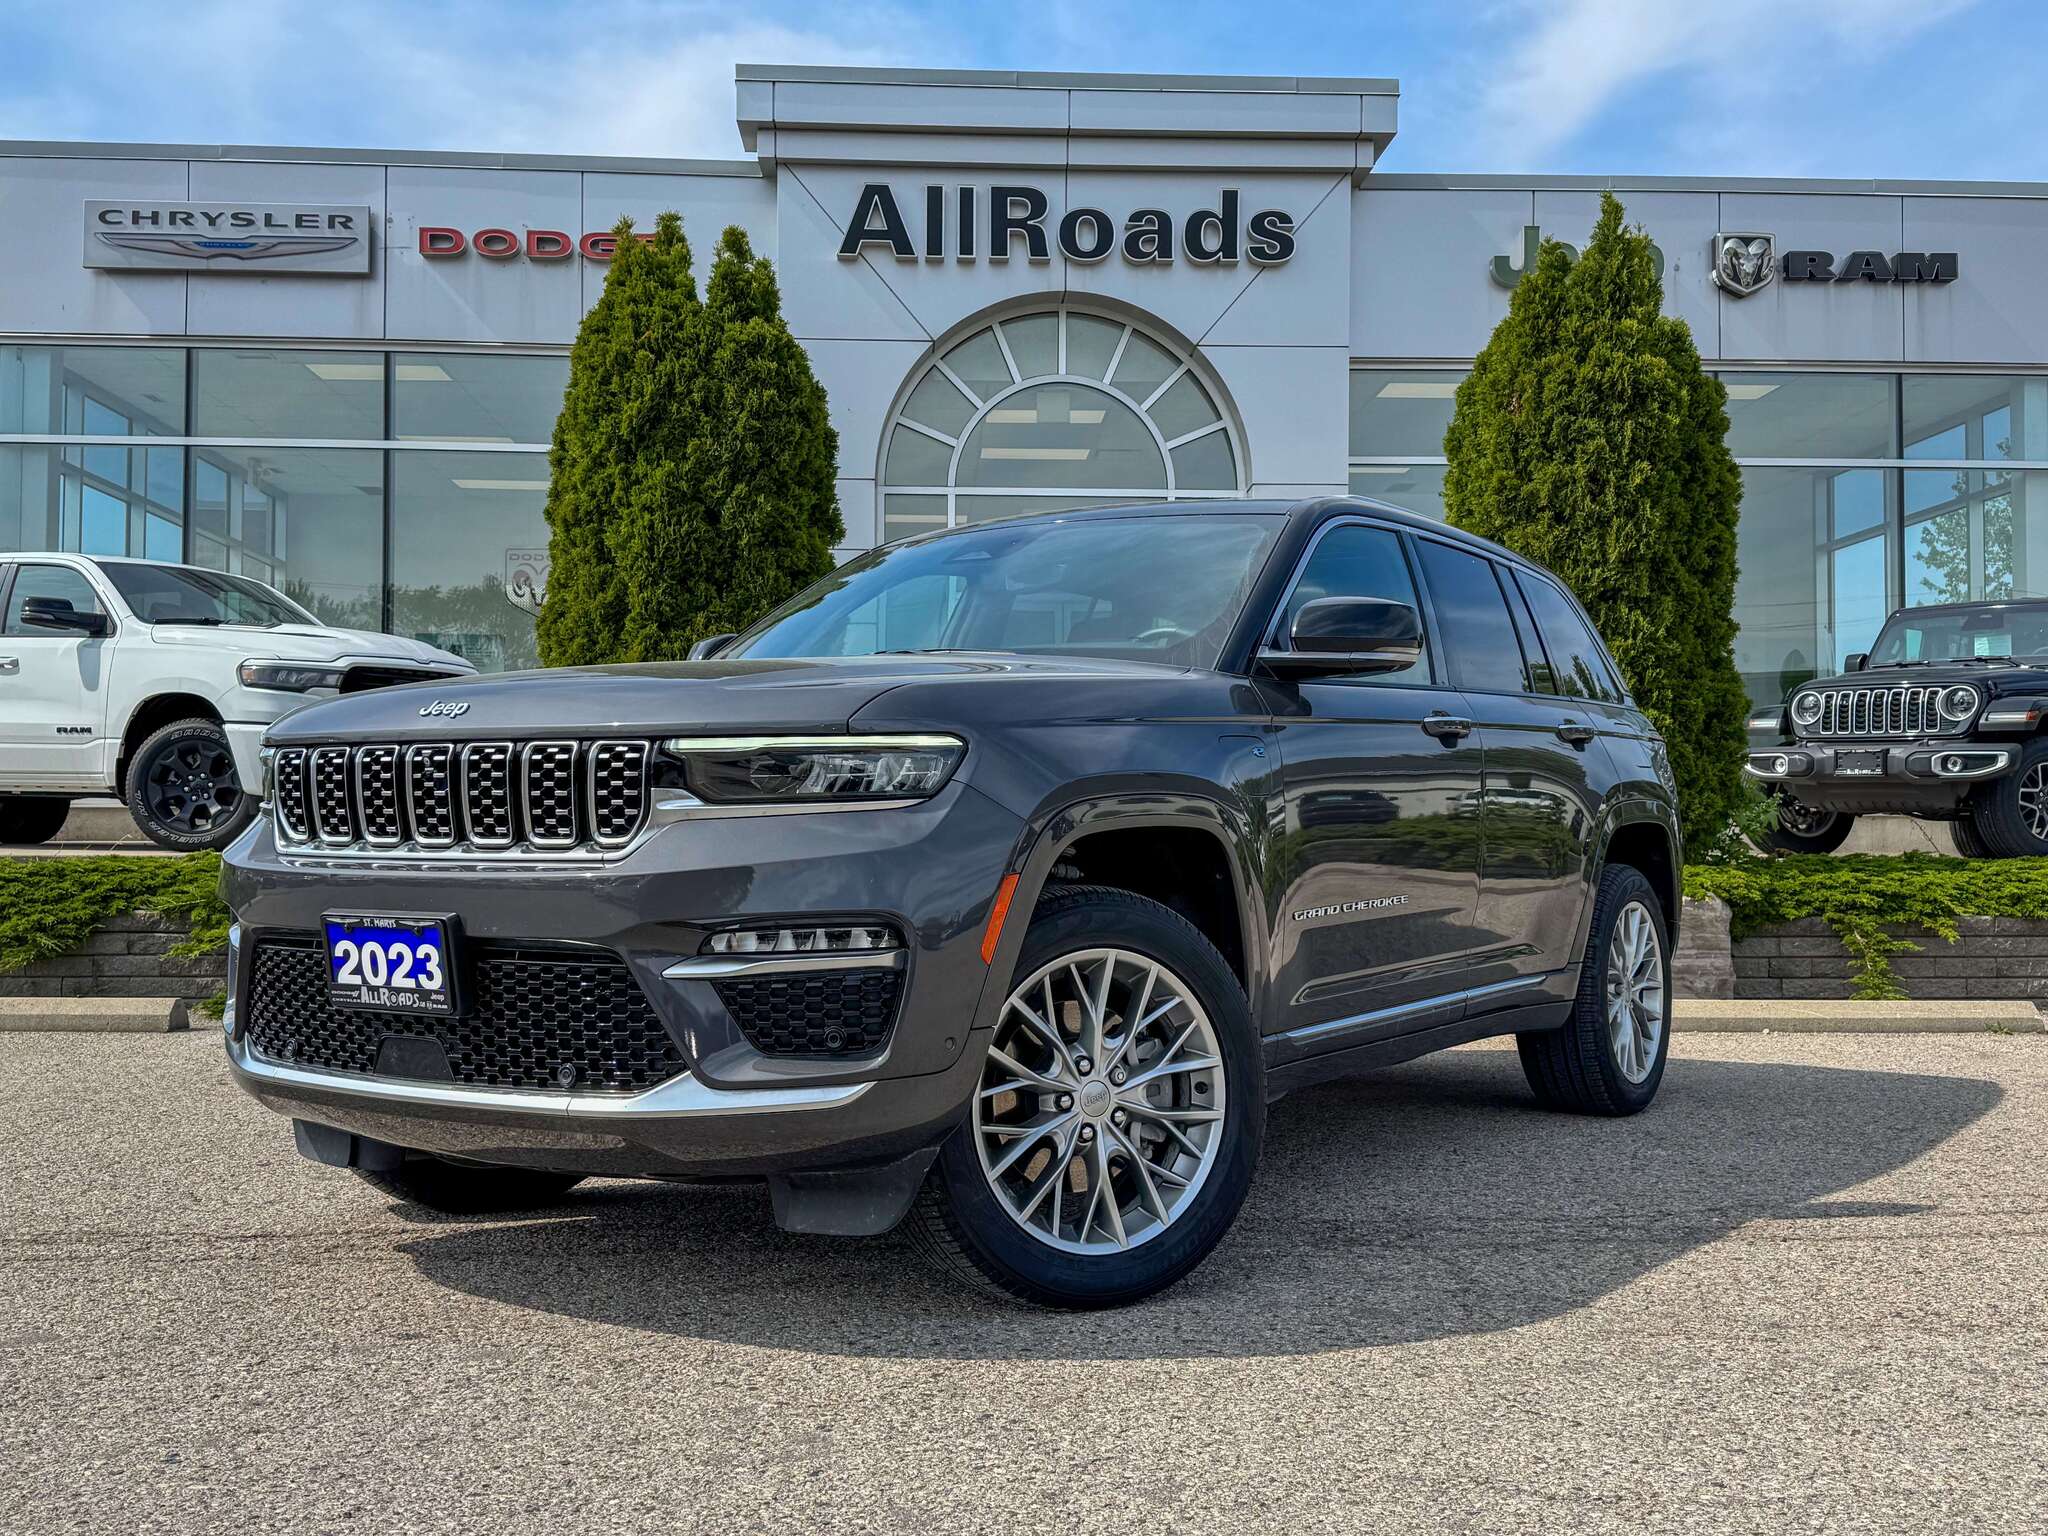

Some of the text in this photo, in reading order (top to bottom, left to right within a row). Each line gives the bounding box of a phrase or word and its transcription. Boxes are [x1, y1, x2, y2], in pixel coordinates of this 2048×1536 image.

[98, 209, 354, 230] CHRYSLER
[838, 182, 1297, 267] AllRoads
[418, 226, 657, 261] DODG
[1783, 250, 1959, 282] RAM
[419, 699, 471, 719] Jeep
[56, 726, 93, 735] RAM
[1292, 894, 1409, 921] GRAND CHEROKEE
[374, 918, 397, 928] MARYS
[334, 940, 443, 990] 2023
[430, 992, 445, 1002] Jeep
